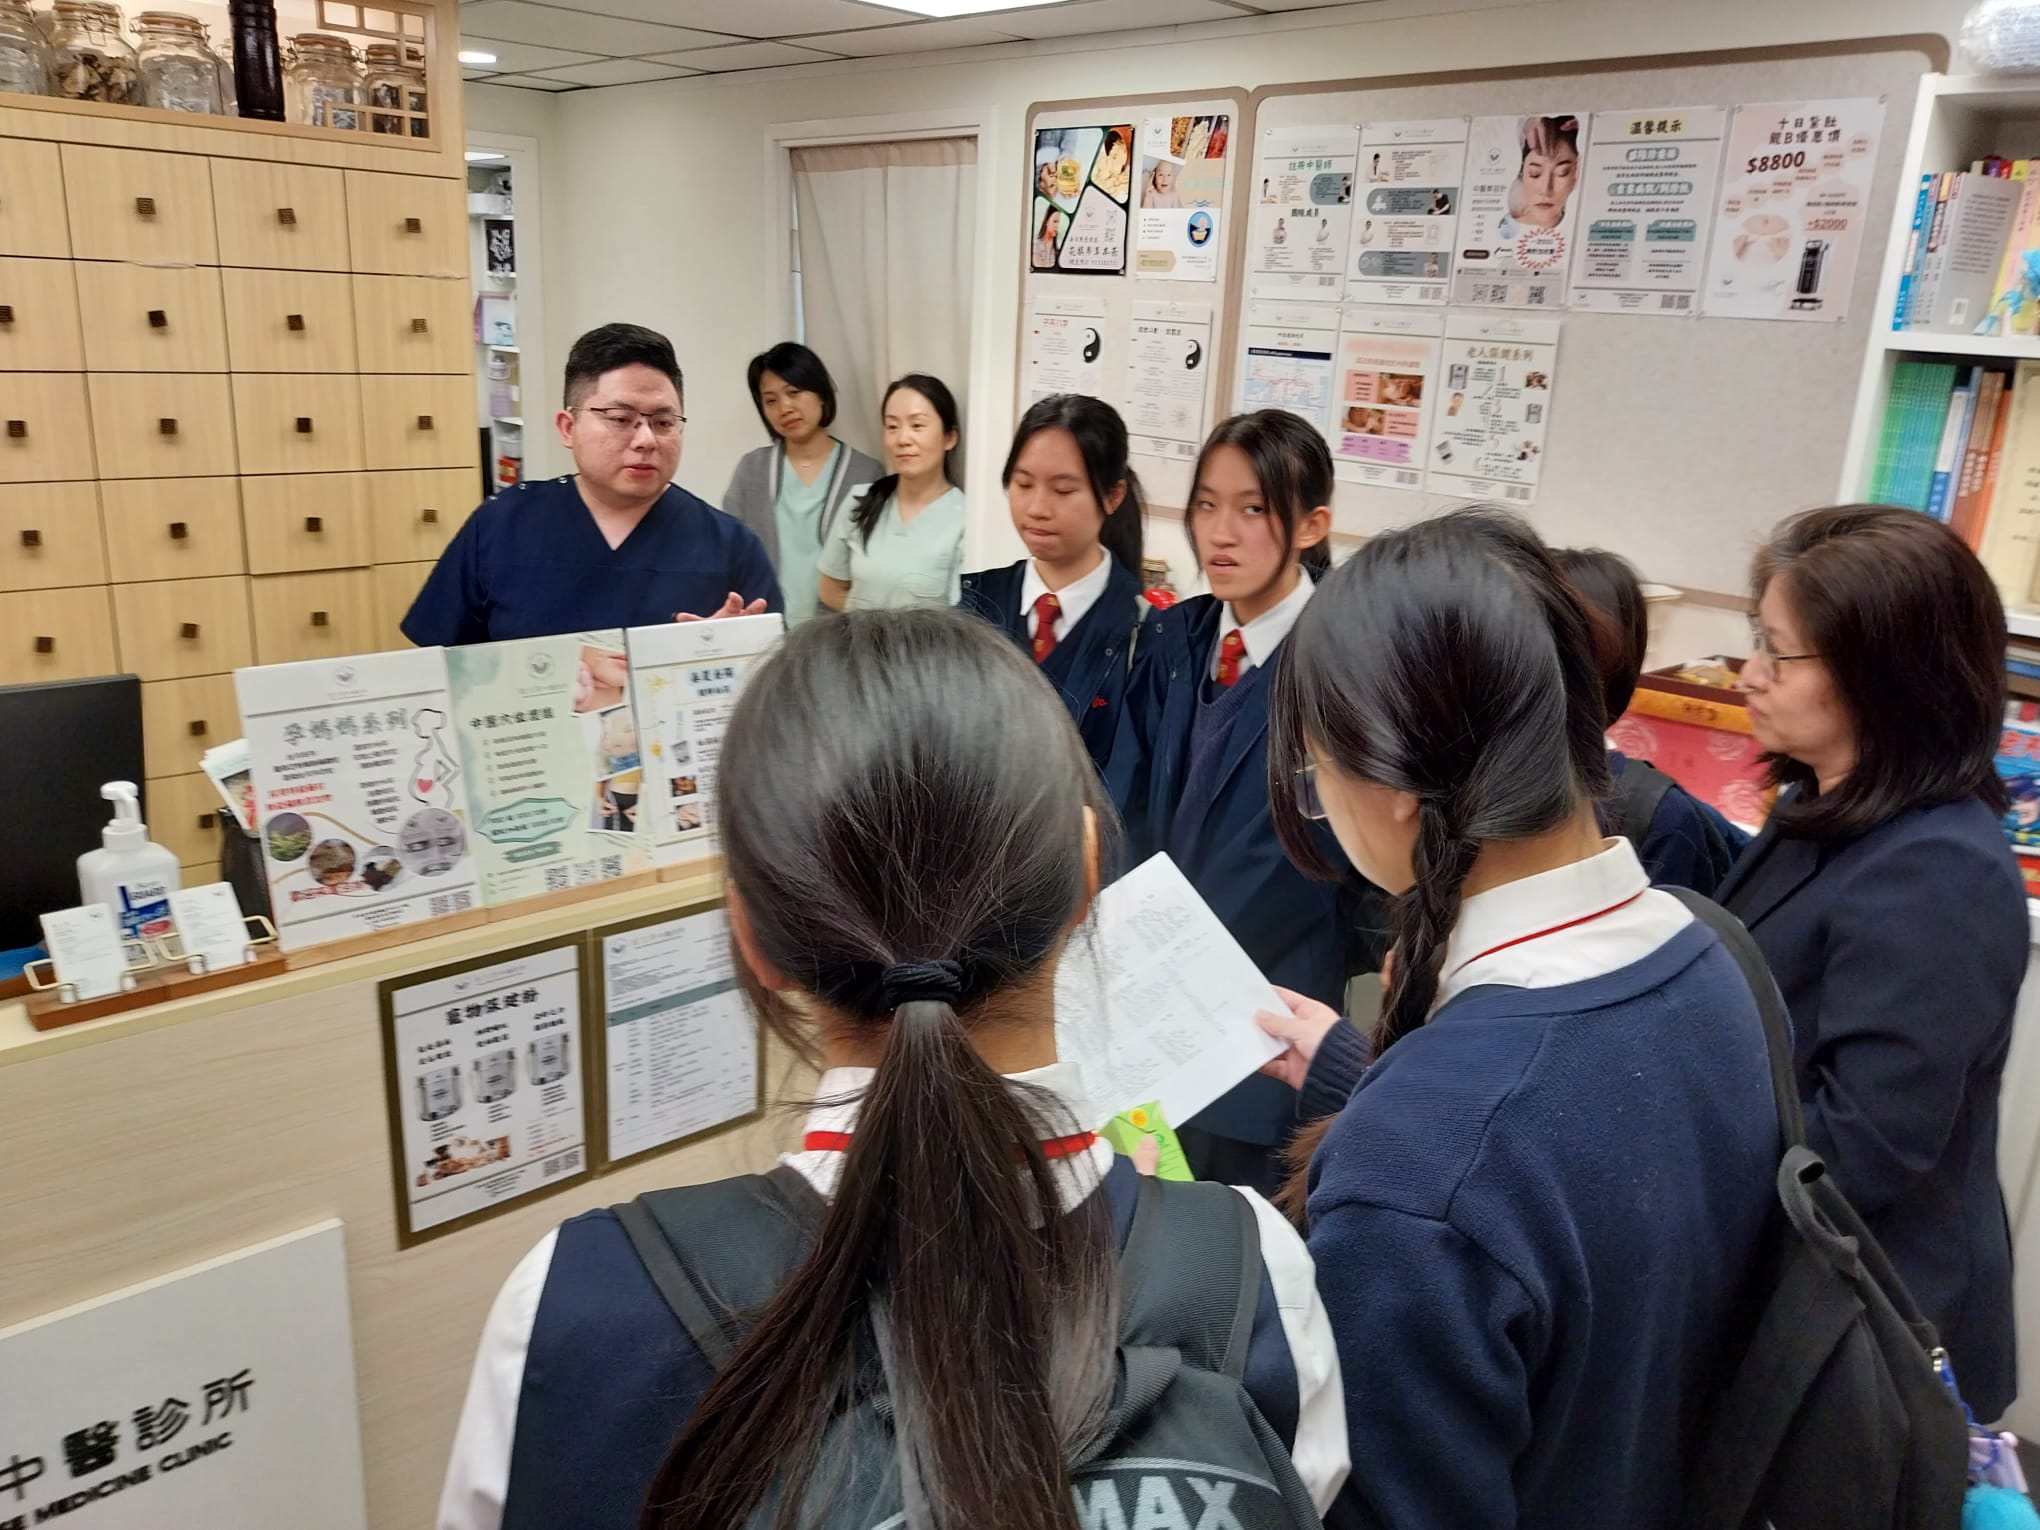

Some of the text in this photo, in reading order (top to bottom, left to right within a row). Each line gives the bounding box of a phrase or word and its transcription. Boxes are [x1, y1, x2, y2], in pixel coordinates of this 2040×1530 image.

[1630, 119, 1683, 135] 溫馨提示
[1745, 151, 1806, 174] $8800
[0, 1368, 256, 1502] 中醫診所
[34, 1463, 155, 1524] MEDICINE
[158, 1431, 235, 1473] CLINIC
